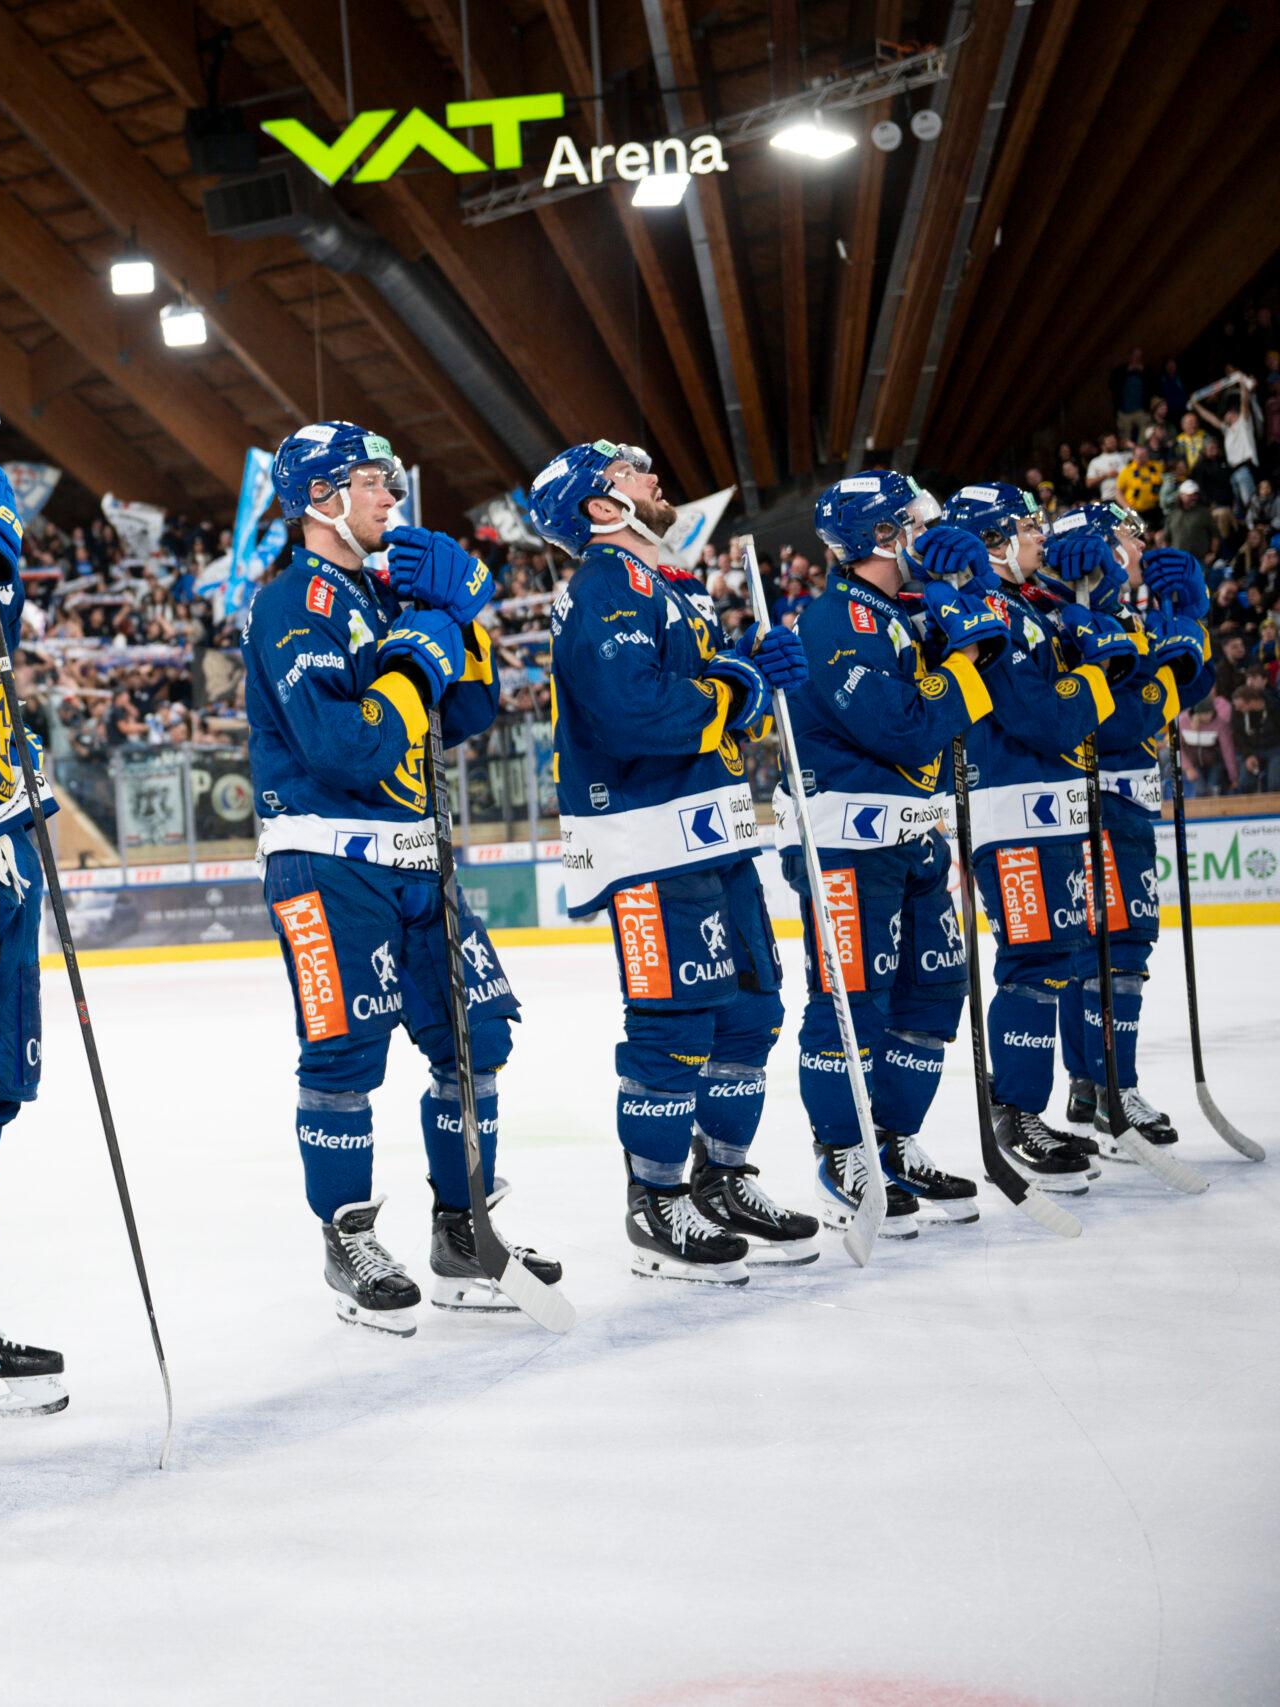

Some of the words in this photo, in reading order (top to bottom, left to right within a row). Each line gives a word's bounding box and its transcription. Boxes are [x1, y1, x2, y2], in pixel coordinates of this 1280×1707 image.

[260, 92, 565, 187] VAT
[543, 134, 729, 188] Arena
[1001, 872, 1029, 940] Castelli
[1019, 869, 1038, 915] Luca
[621, 914, 649, 993] Castelli
[638, 913, 659, 967] Luca
[836, 914, 856, 964] Luca
[297, 955, 327, 1036] Castelli
[309, 945, 334, 1004] Luca
